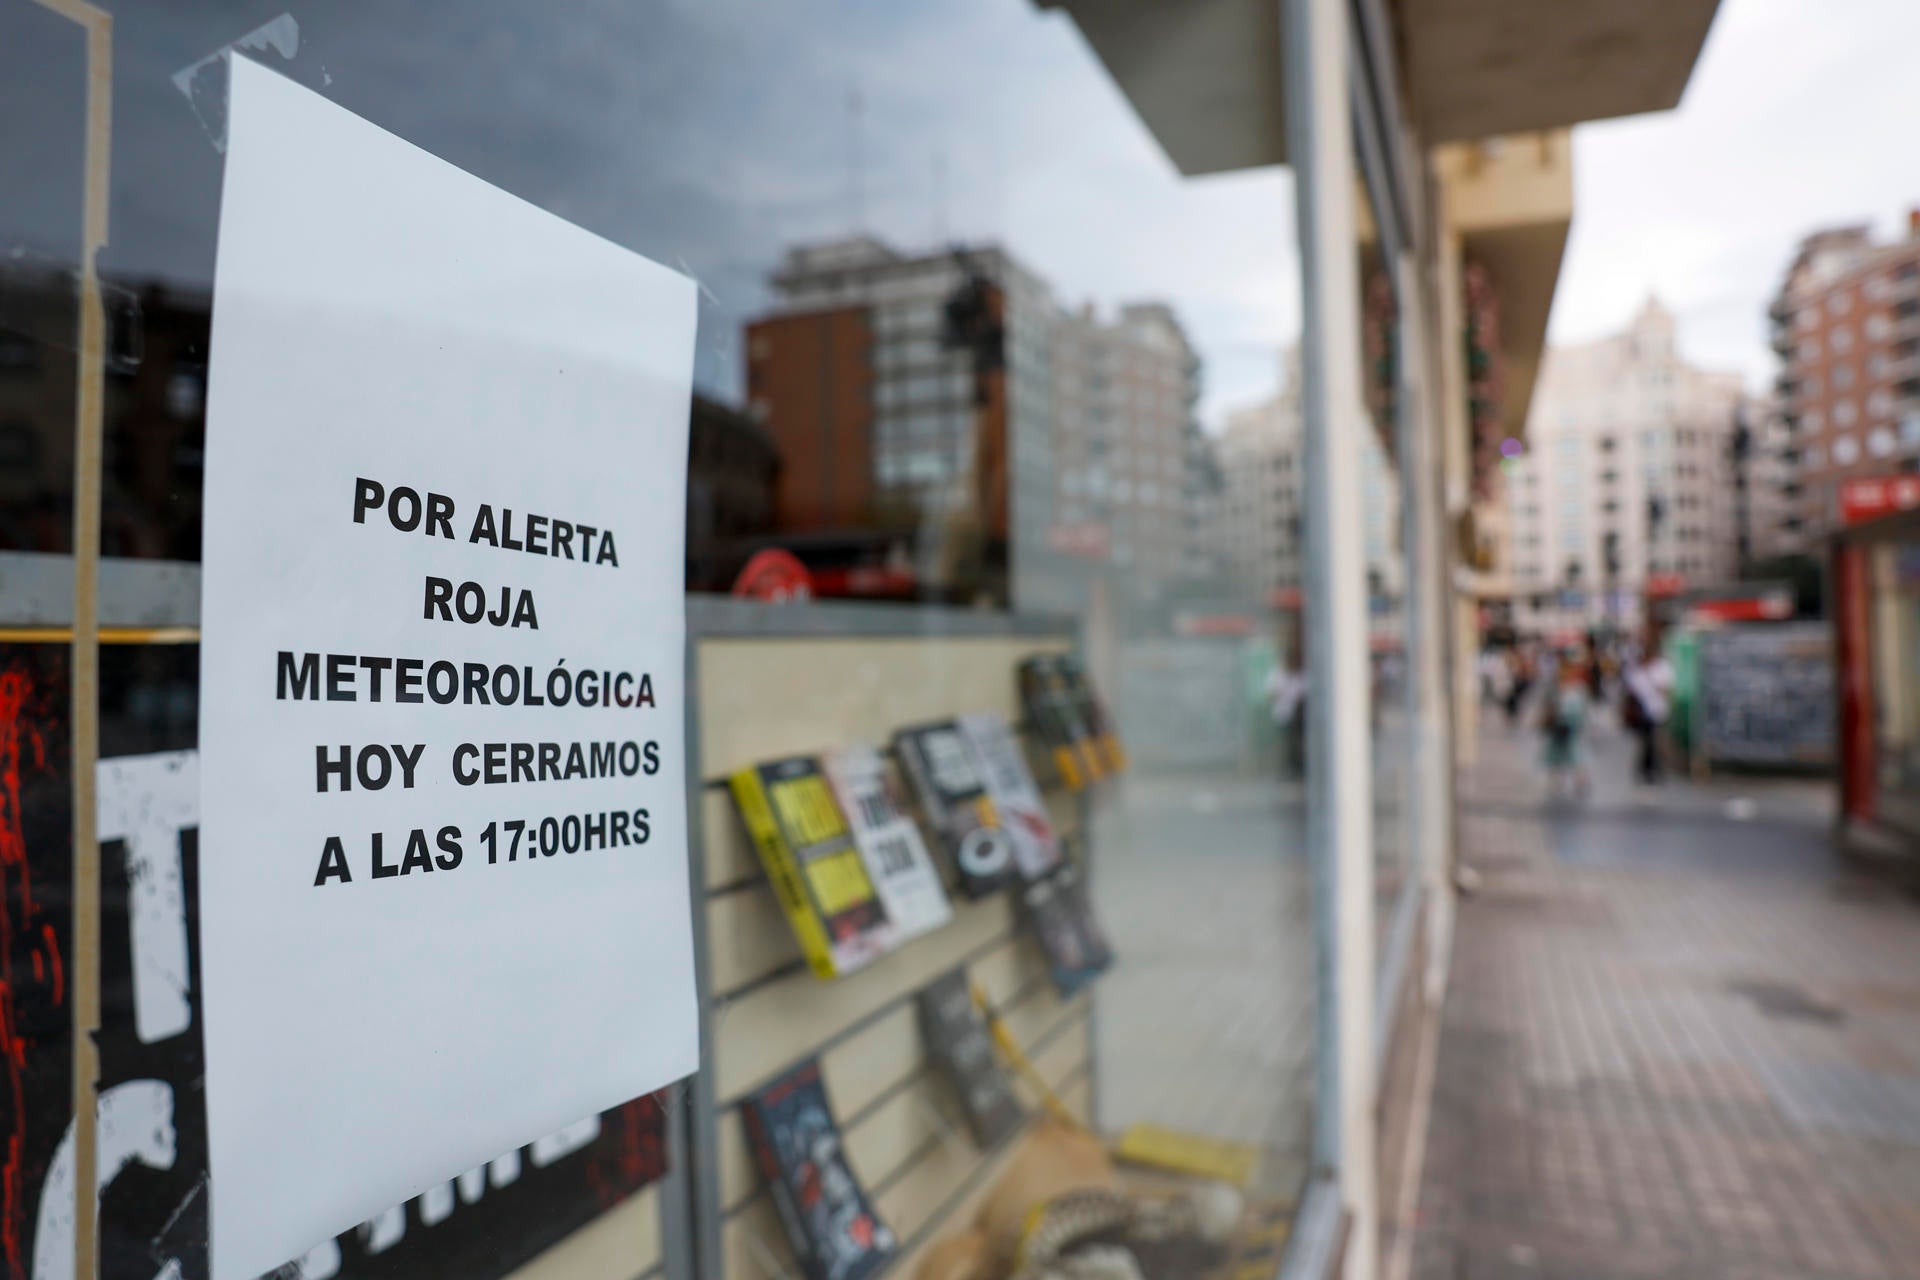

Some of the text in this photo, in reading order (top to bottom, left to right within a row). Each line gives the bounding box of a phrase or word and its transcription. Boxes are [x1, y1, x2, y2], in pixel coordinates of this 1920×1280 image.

[353, 477, 620, 568] POR ALERTA
[423, 575, 539, 630] ROJA
[276, 650, 657, 708] METEOROLÓGICA
[315, 740, 661, 793] HOY CERRAMOS
[313, 808, 651, 887] A LAS 17:00HRS
